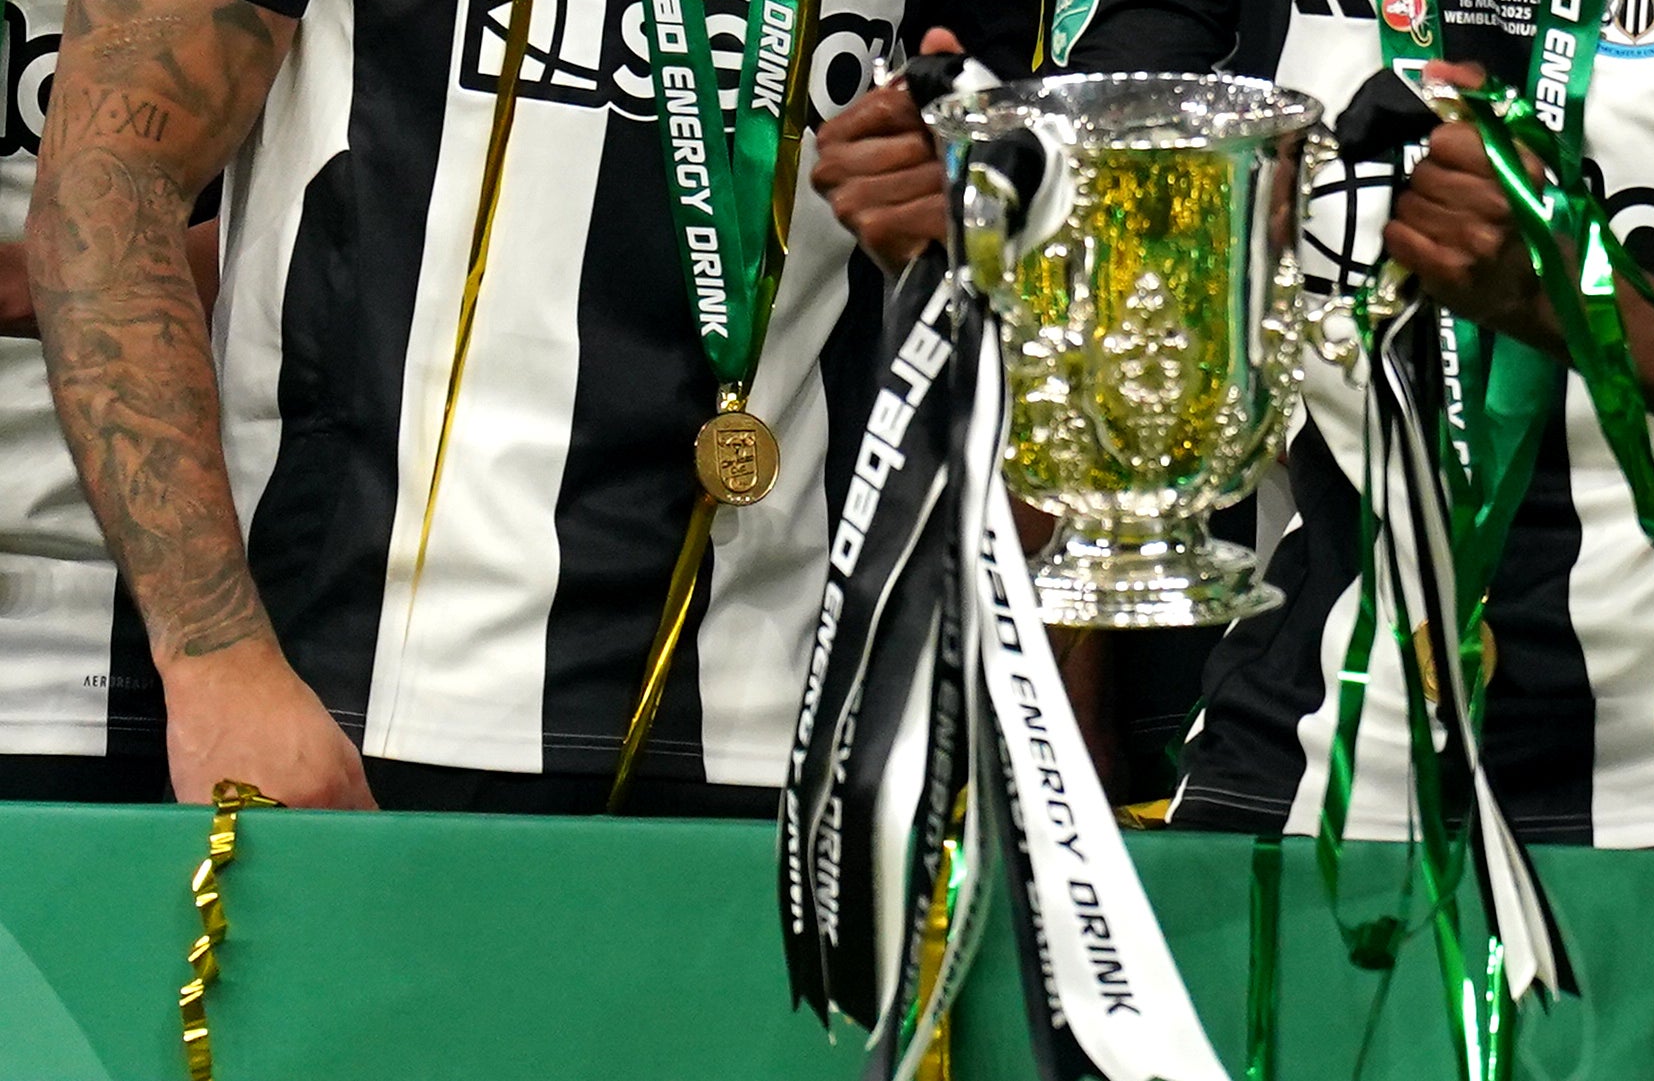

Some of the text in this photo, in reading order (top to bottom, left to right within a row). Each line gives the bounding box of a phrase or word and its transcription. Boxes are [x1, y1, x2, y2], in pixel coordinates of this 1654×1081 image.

[751, 0, 794, 118] DRINK
[1501, 5, 1532, 20] 2025
[1535, 28, 1576, 132] ENER
[662, 66, 713, 216] ENERGY
[685, 226, 728, 339] DRINK
[1010, 672, 1142, 1017] ENERGY DRINK
